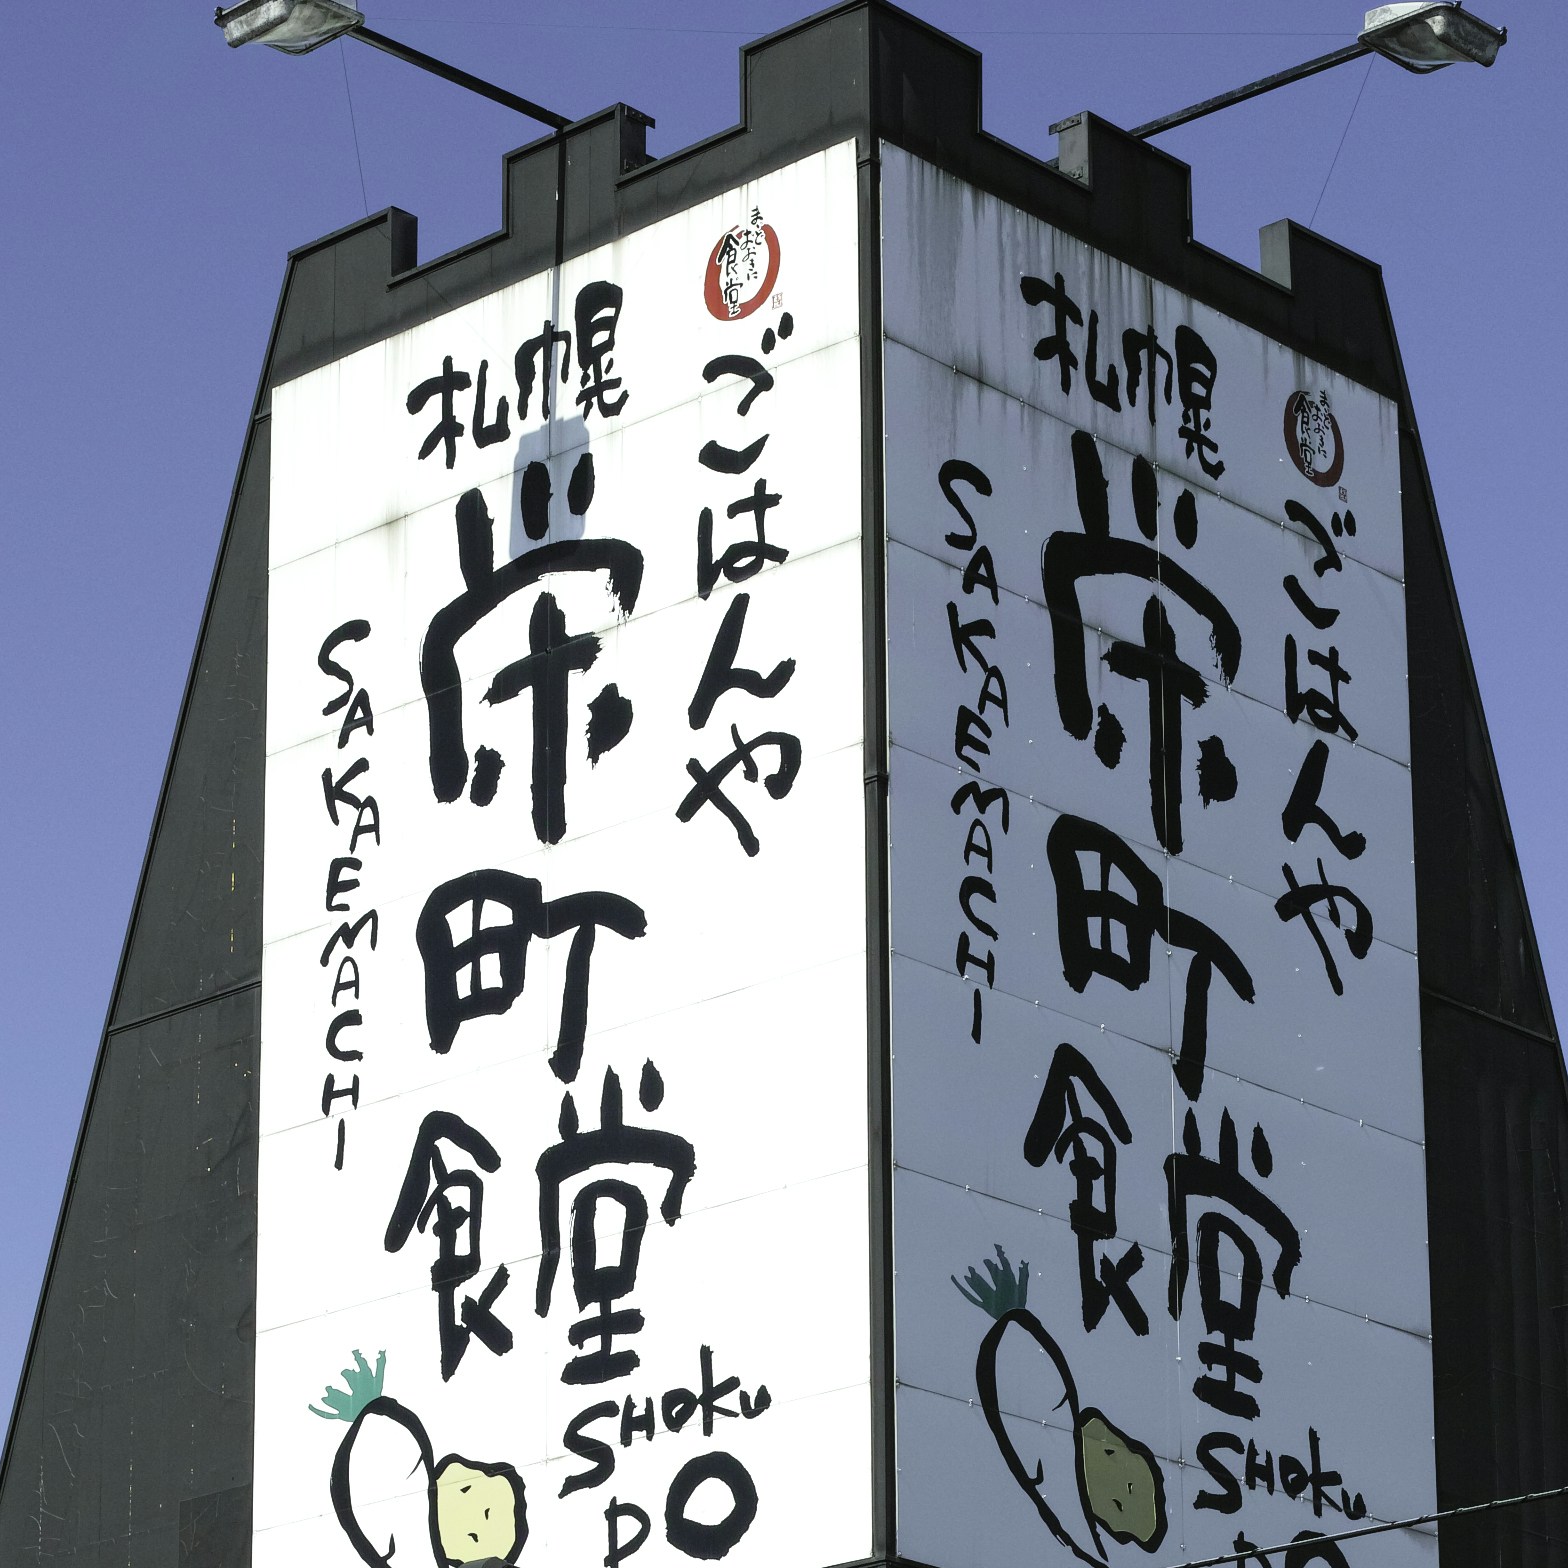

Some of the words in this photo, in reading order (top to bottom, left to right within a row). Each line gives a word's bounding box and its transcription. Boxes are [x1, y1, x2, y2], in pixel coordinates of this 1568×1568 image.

[407, 281, 631, 469] 札幌
[676, 312, 801, 857] ごはんや
[1020, 271, 1225, 480] 札幌
[318, 619, 380, 1170] SAKAEMACHI
[938, 459, 1010, 1044] SAKAEMACHI
[1274, 499, 1374, 996] ごはんや
